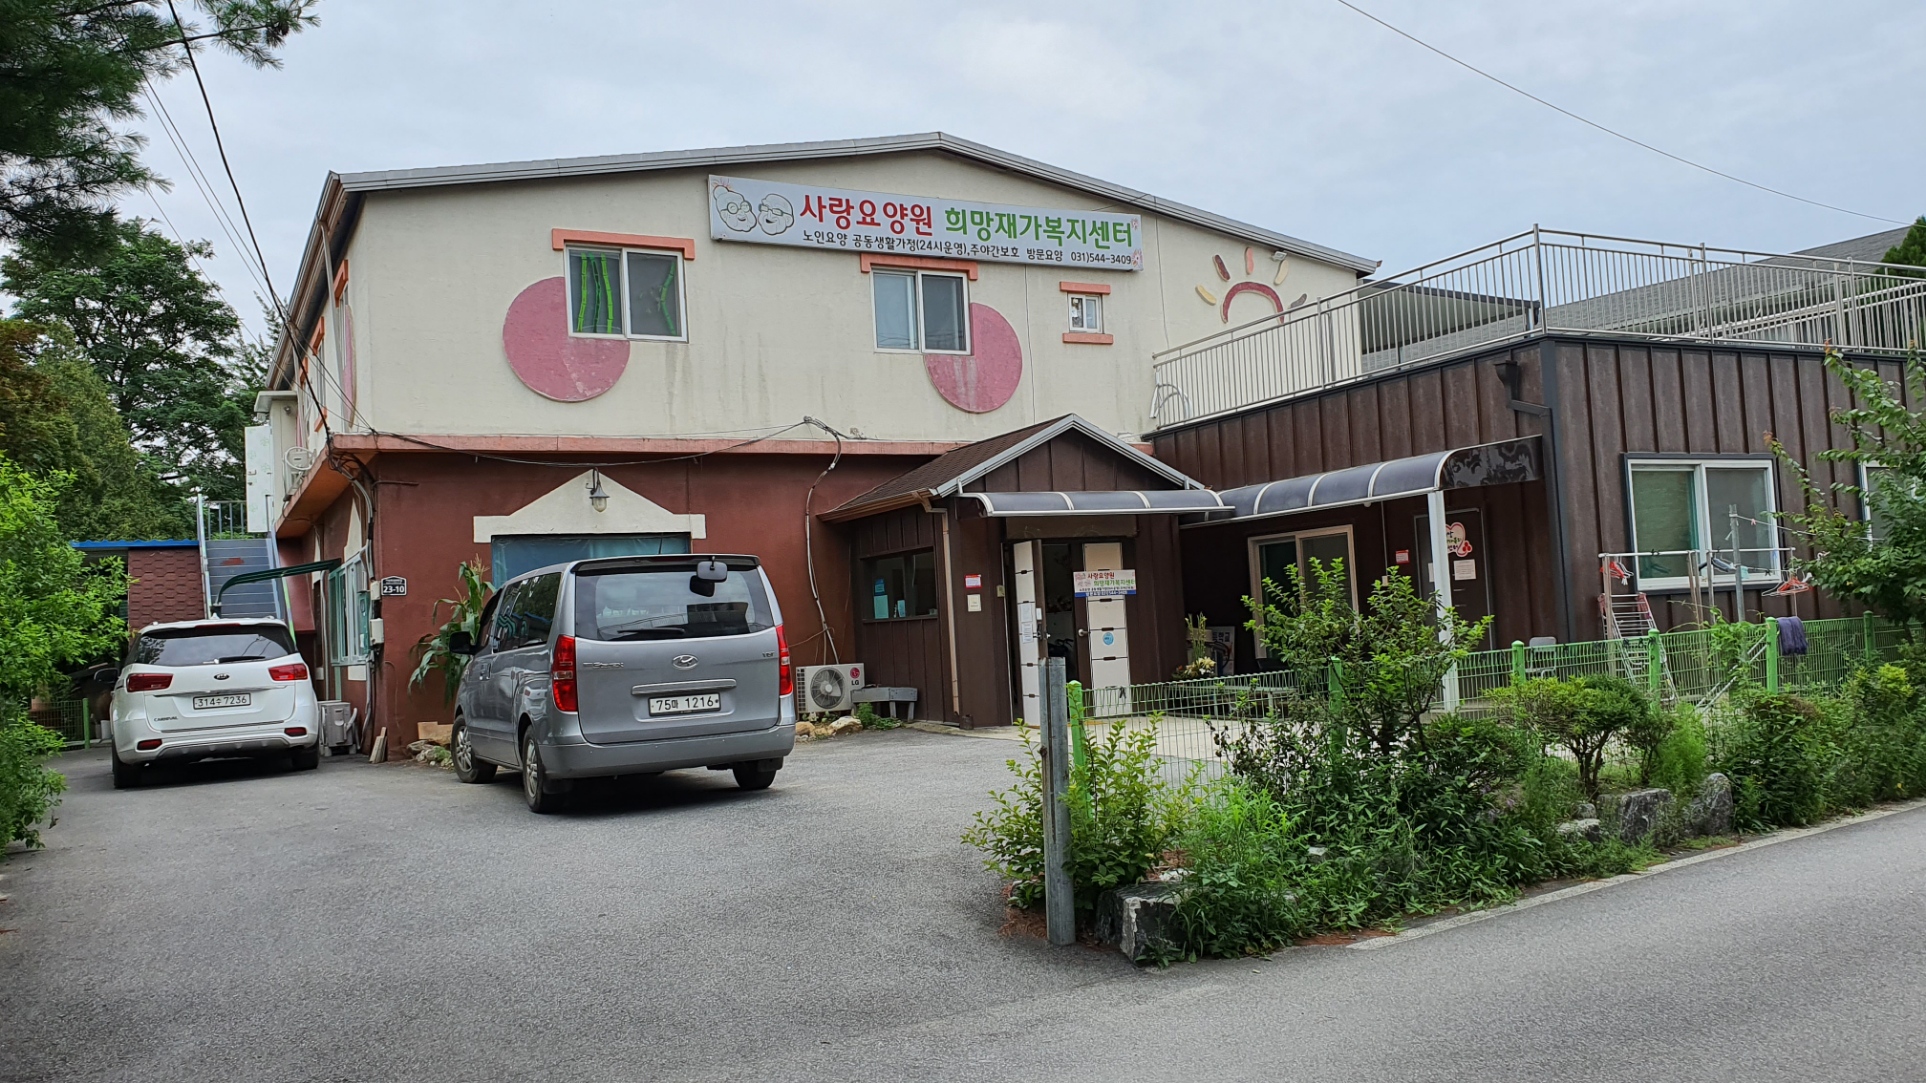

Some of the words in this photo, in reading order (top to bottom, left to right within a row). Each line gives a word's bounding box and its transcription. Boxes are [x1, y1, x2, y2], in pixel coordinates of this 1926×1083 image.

[799, 194, 933, 237] 사랑요양원
[944, 207, 1132, 250] 희망재가복지센터
[802, 229, 848, 247] 노인요양
[1026, 248, 1063, 262] 방문요양
[1070, 251, 1132, 265] 031)544-3409
[223, 695, 247, 705] 7236
[685, 695, 714, 708] 1216
